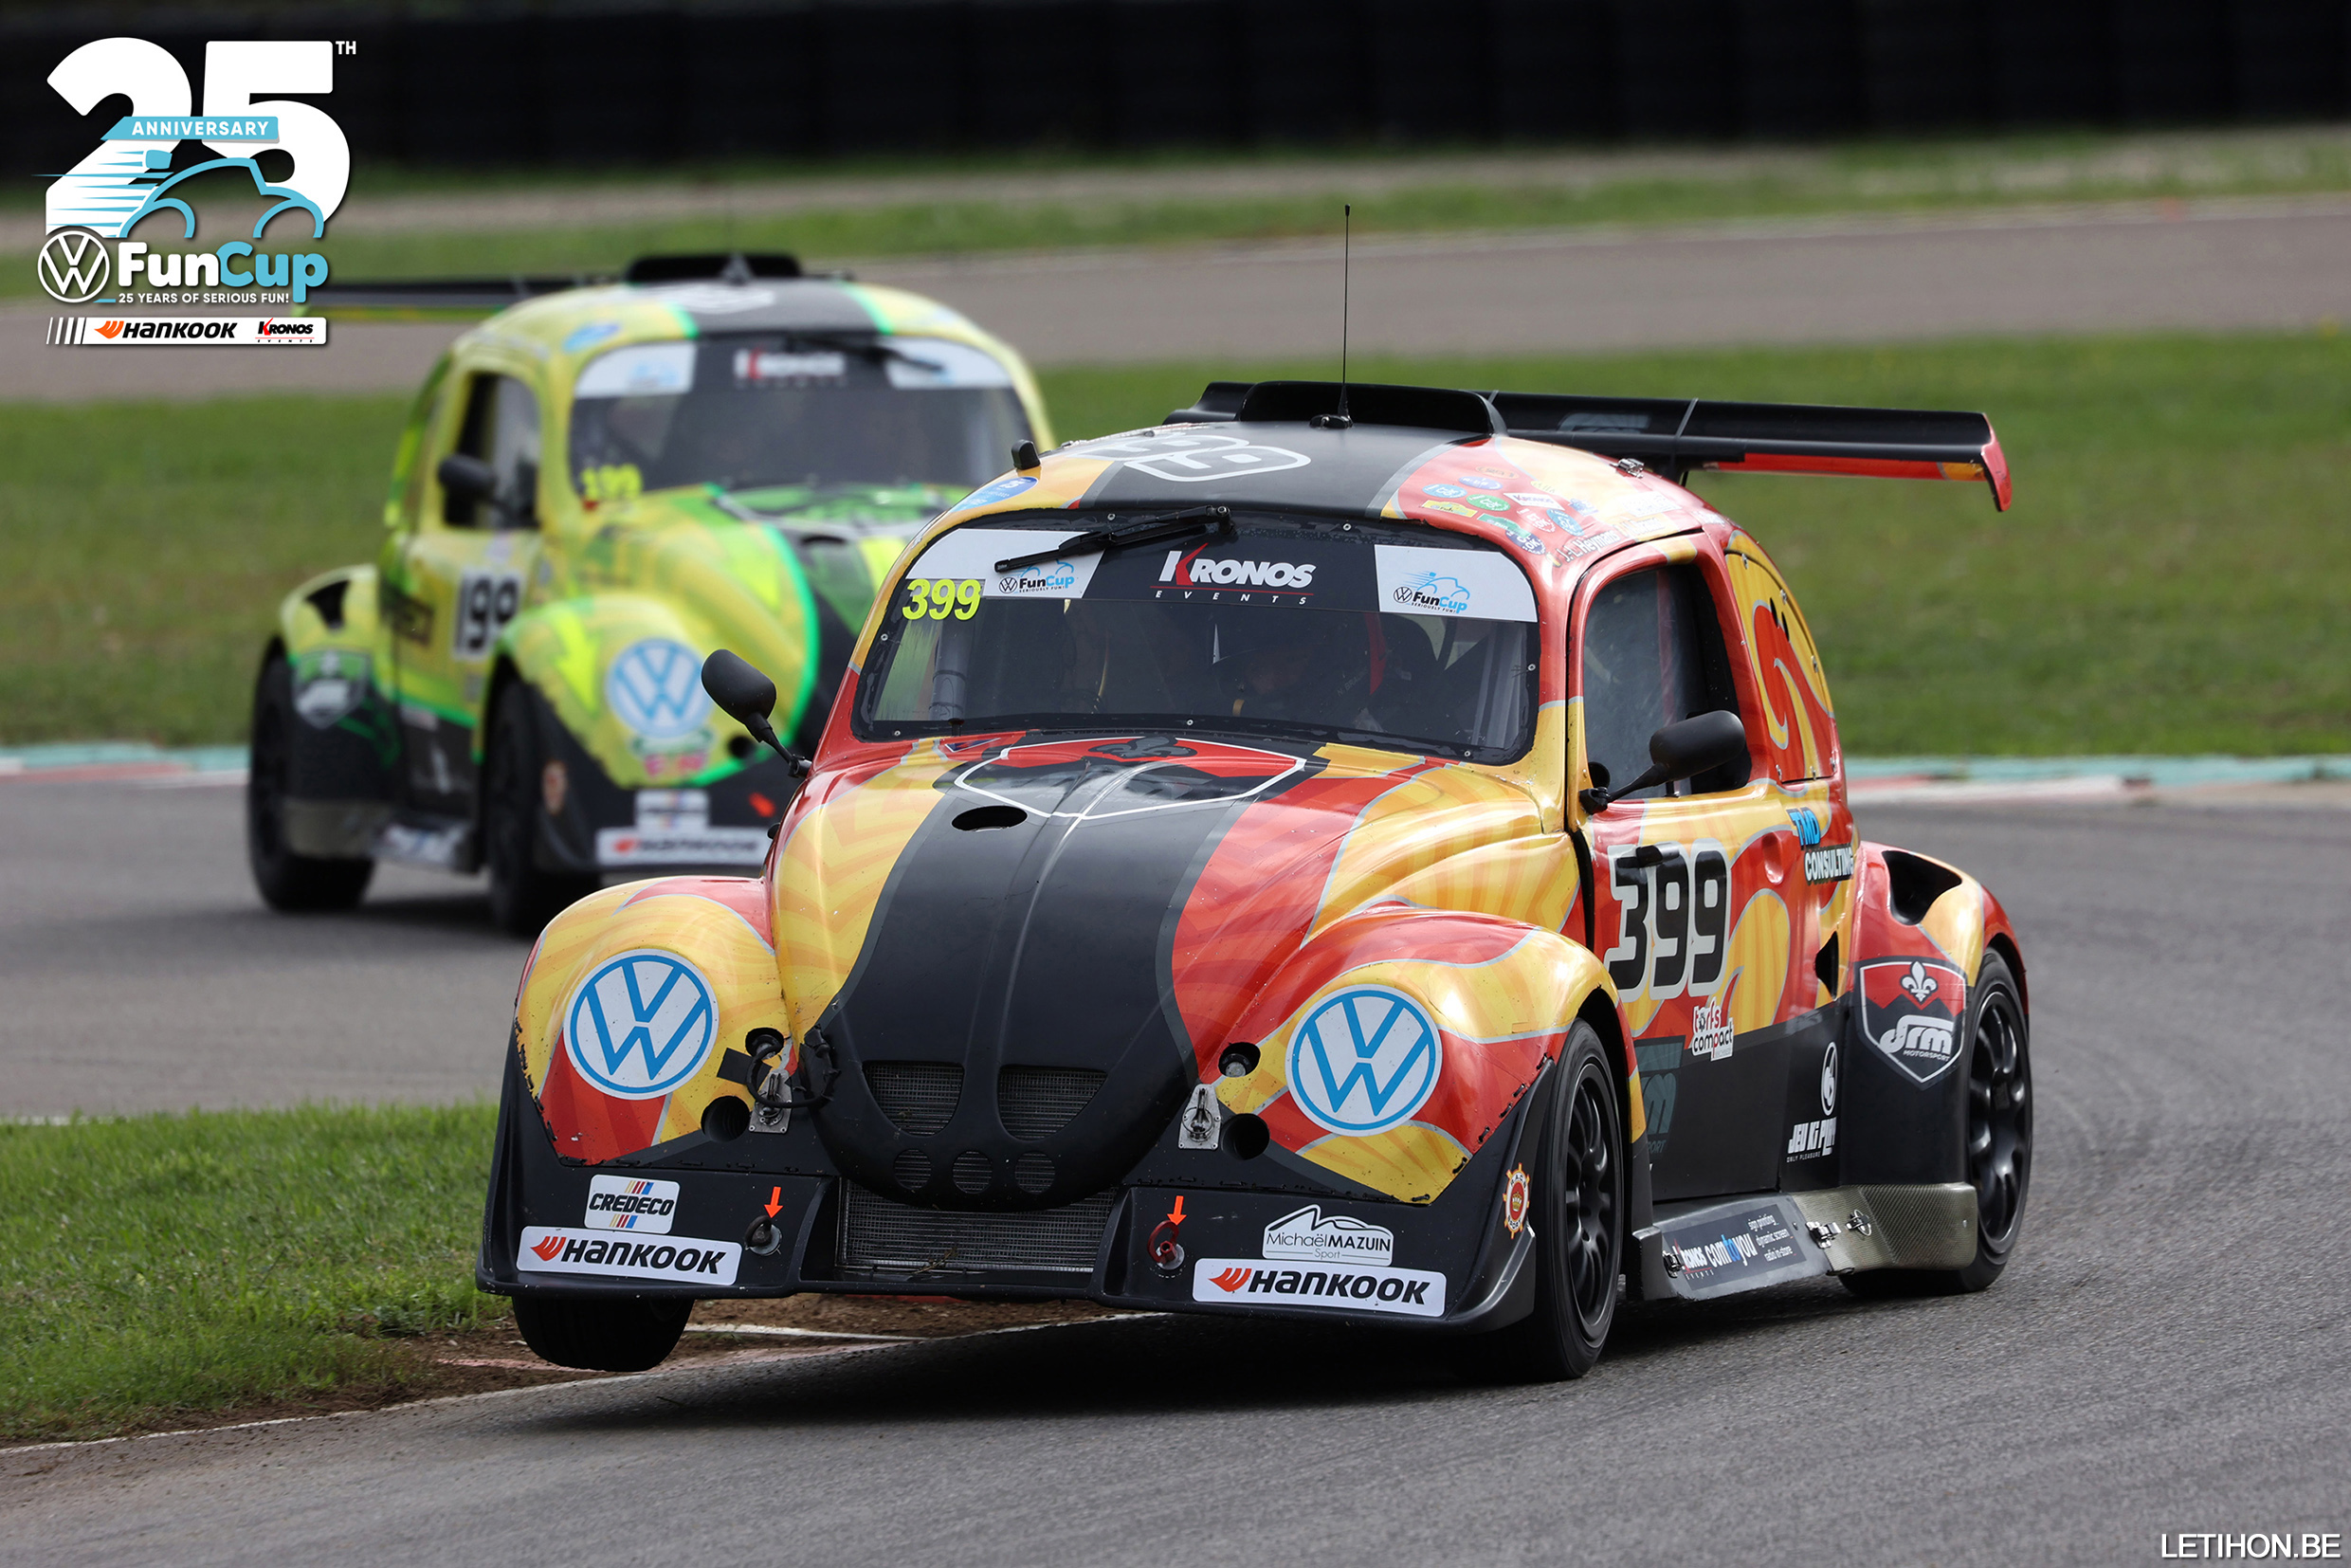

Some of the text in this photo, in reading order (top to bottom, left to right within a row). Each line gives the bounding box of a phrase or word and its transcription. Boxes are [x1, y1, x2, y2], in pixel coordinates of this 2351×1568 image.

[1158, 542, 1317, 589] KRONOS
[1019, 575, 1075, 589] FunCup
[902, 578, 981, 620] 399
[1156, 591, 1306, 605] EVENTS
[1411, 602, 1441, 611] SERIOUSLY
[1412, 591, 1468, 614] FunCup
[1804, 847, 1854, 881] CONSULTING
[1609, 846, 1727, 990] 399
[1693, 1021, 1733, 1058] compact
[1903, 1048, 1951, 1062] MOTORSPORT
[589, 1193, 674, 1216] CREDECO
[1267, 1232, 1391, 1251] Michaël MAZUIN
[1704, 1234, 1758, 1268] comtoyou
[1314, 1249, 1340, 1260] Sport
